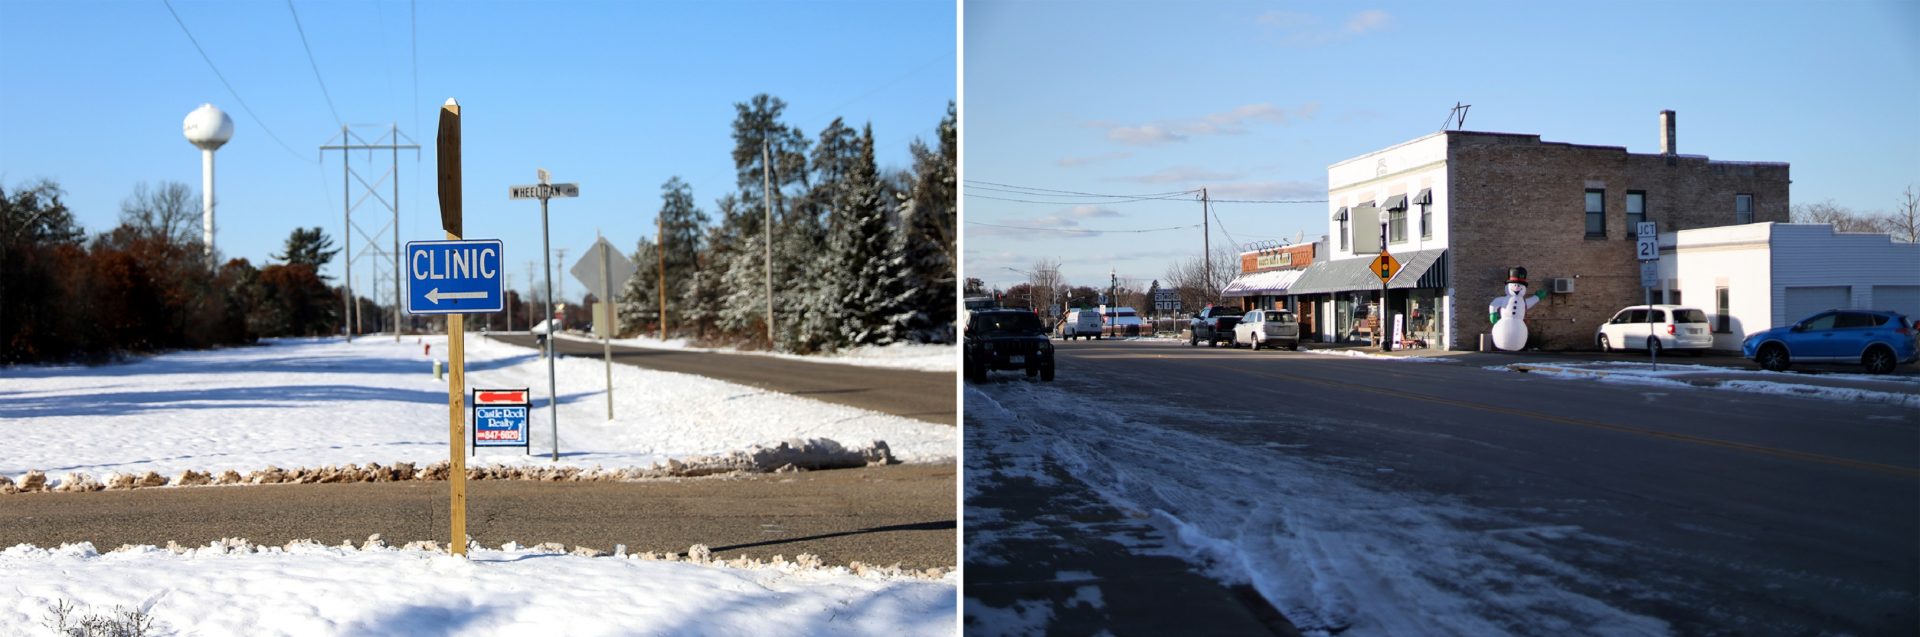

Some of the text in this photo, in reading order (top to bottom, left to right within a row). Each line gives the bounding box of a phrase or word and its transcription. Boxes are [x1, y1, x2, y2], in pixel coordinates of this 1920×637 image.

[1639, 224, 1655, 235] JCT
[1640, 242, 1655, 256] 21
[413, 248, 495, 280] CLINIC
[478, 409, 524, 418] Castle Rock
[488, 418, 514, 430] Realty
